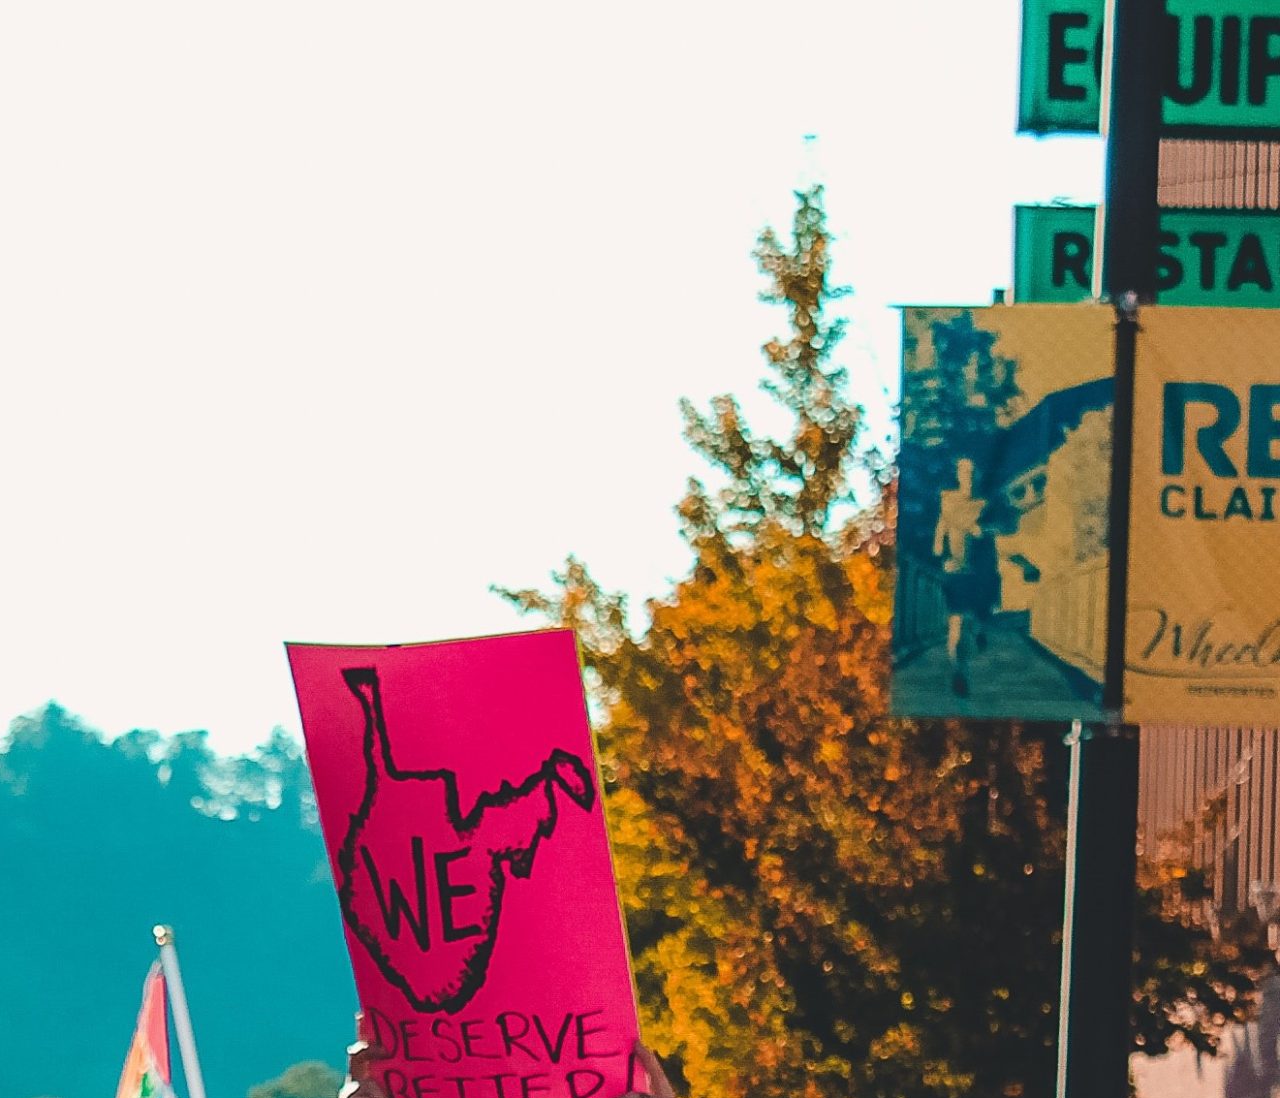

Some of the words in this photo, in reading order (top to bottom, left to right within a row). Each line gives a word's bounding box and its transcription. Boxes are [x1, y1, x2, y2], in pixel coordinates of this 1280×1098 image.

[1048, 11, 1280, 106] EUIP
[1051, 231, 1275, 291] RSTA
[1160, 484, 1277, 521] CLAI
[360, 836, 484, 952] WE
[368, 1008, 621, 1064] DESERVE
